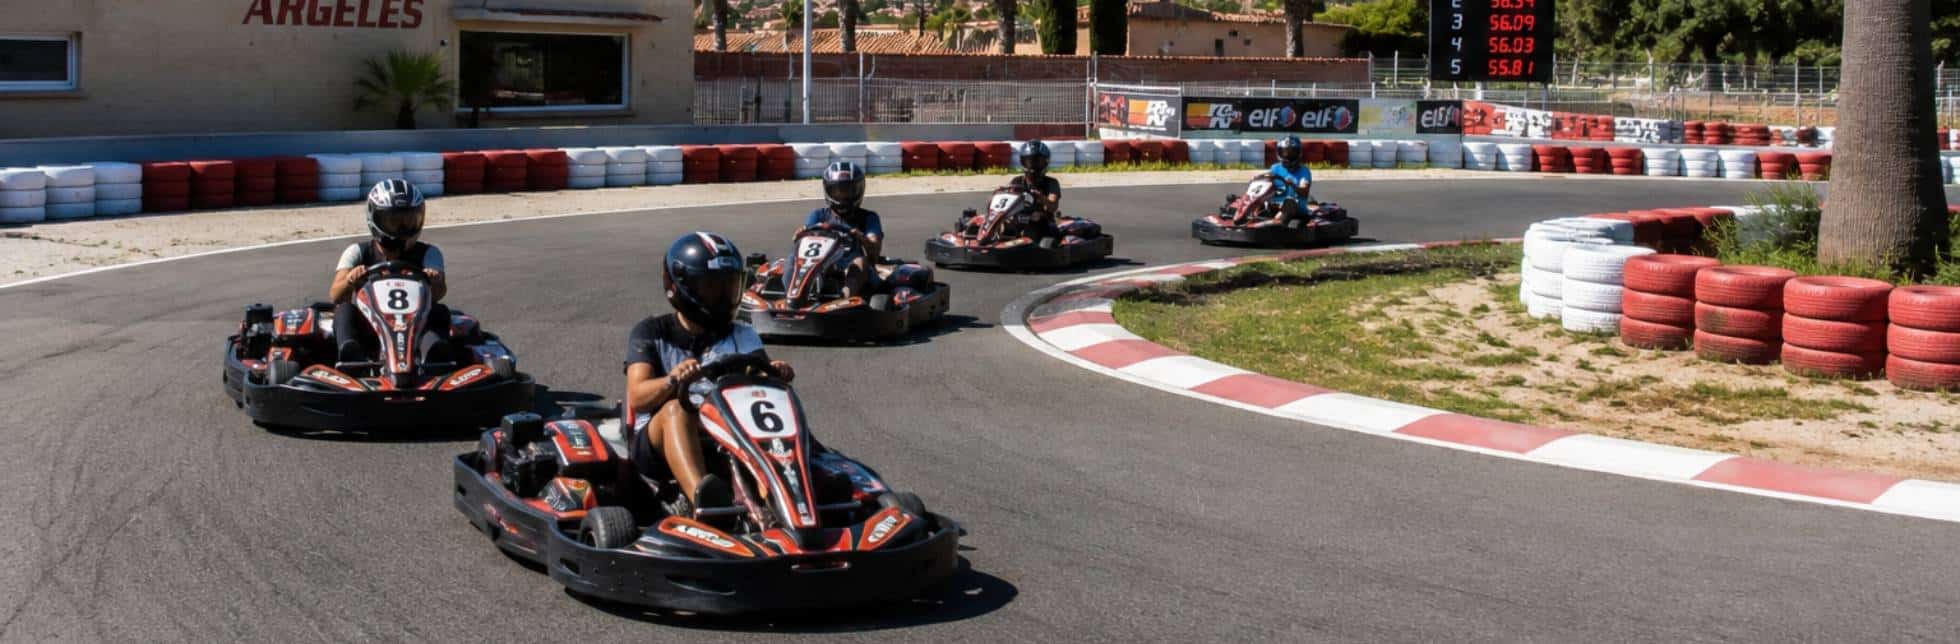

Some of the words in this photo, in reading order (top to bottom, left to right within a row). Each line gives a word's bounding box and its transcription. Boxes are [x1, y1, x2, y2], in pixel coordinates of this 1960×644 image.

[242, 0, 424, 28] ARGELES
[1451, 13, 1463, 30] 3
[1489, 14, 1536, 31] 56.09
[1451, 37, 1463, 52] 4
[1488, 37, 1535, 53] 56.03
[1450, 59, 1461, 75] 5
[1488, 59, 1535, 76] 55.81
[1248, 106, 1281, 127] elf
[1301, 107, 1334, 128] elf
[388, 288, 409, 310] 8
[751, 401, 784, 433] 6
